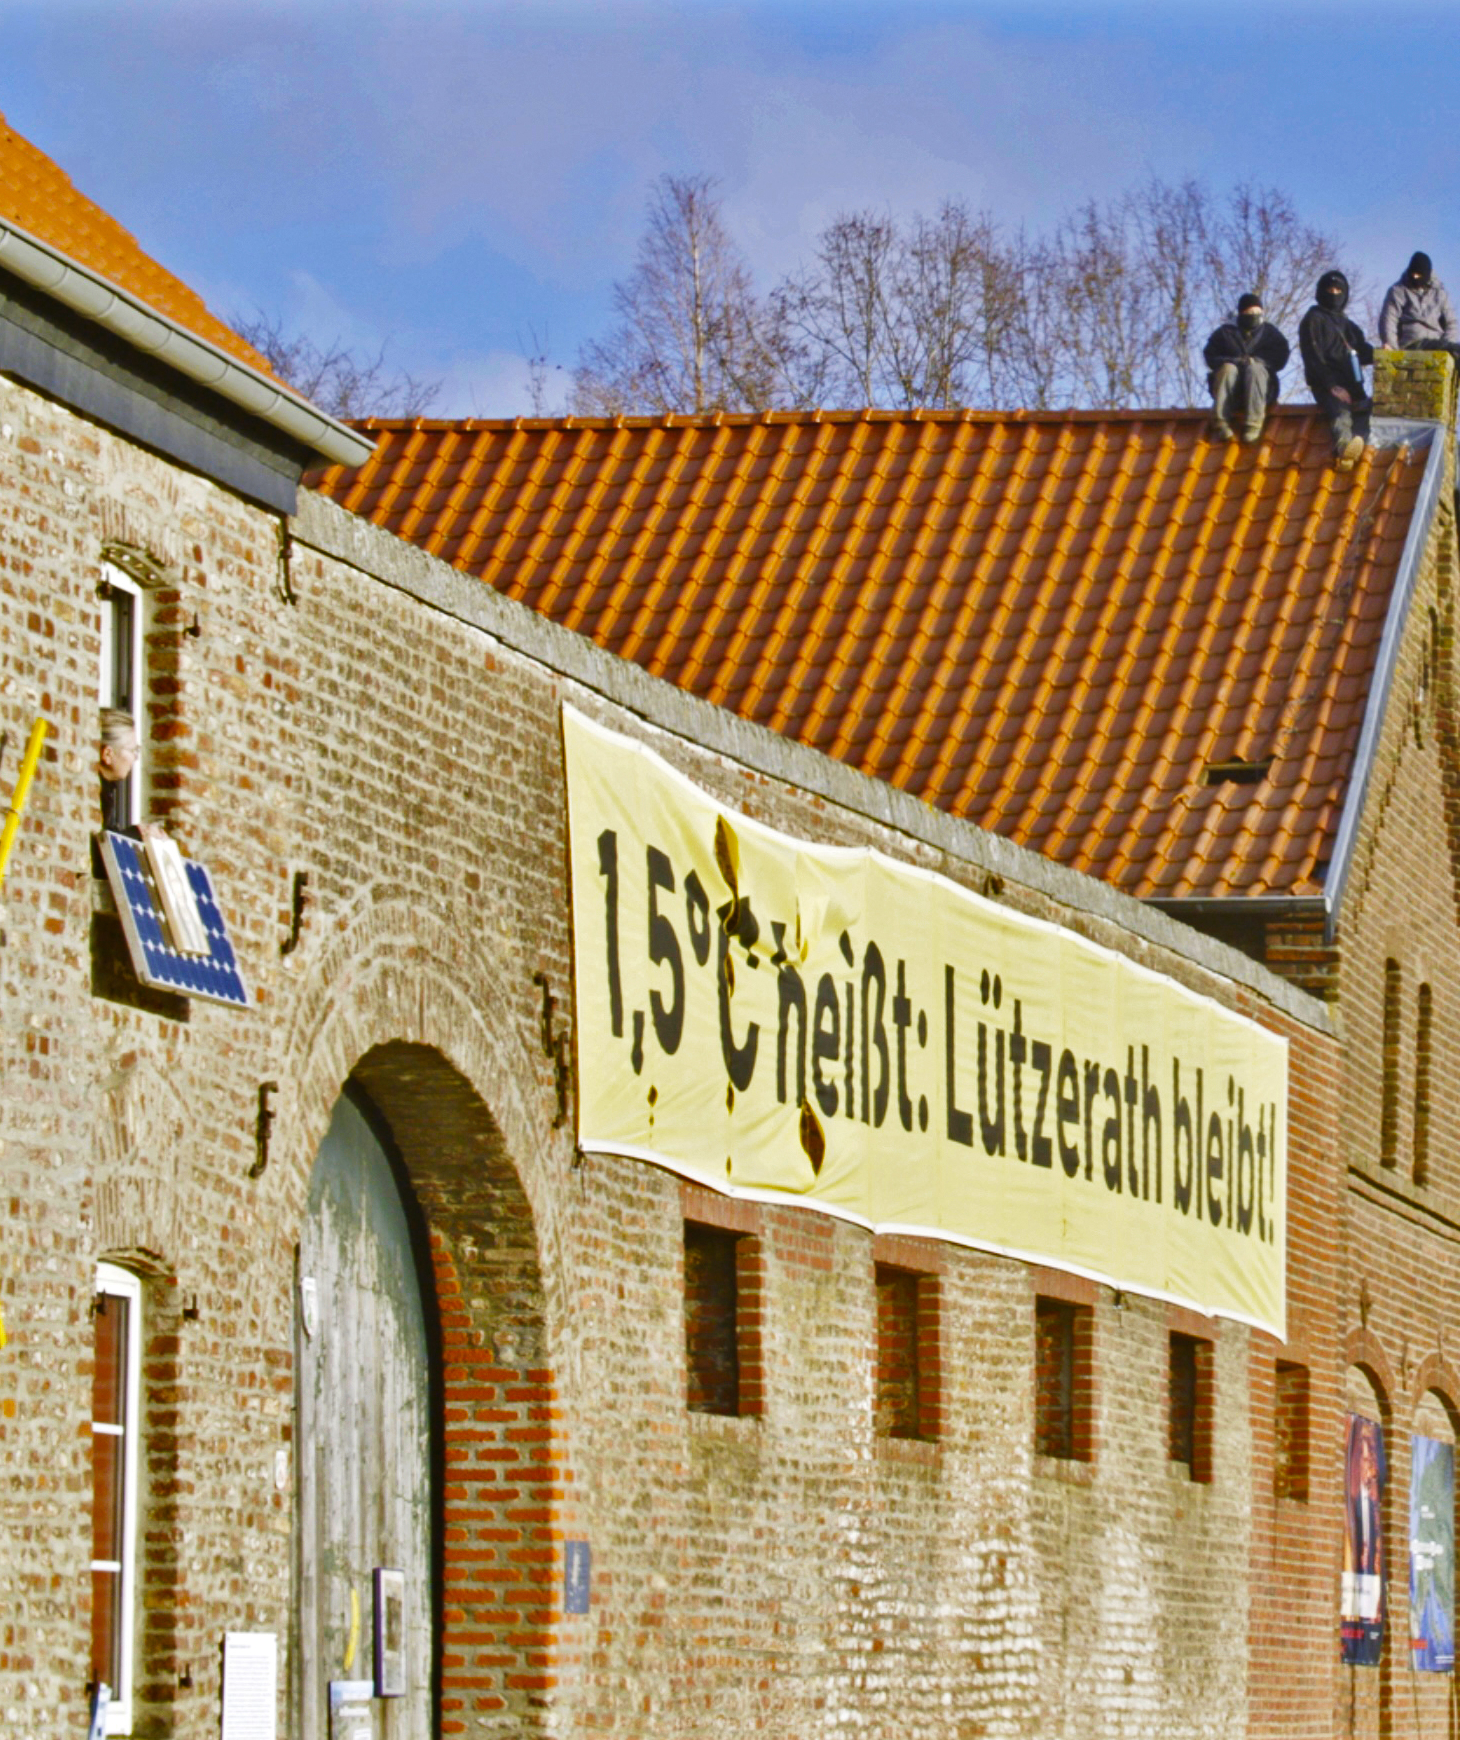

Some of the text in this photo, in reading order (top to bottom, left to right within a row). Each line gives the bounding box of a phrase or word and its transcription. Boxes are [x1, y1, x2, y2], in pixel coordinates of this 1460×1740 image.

[770, 920, 928, 1133] heißt:
[945, 964, 1163, 1204] Lützerath
[1173, 1056, 1276, 1245] bleibt!
